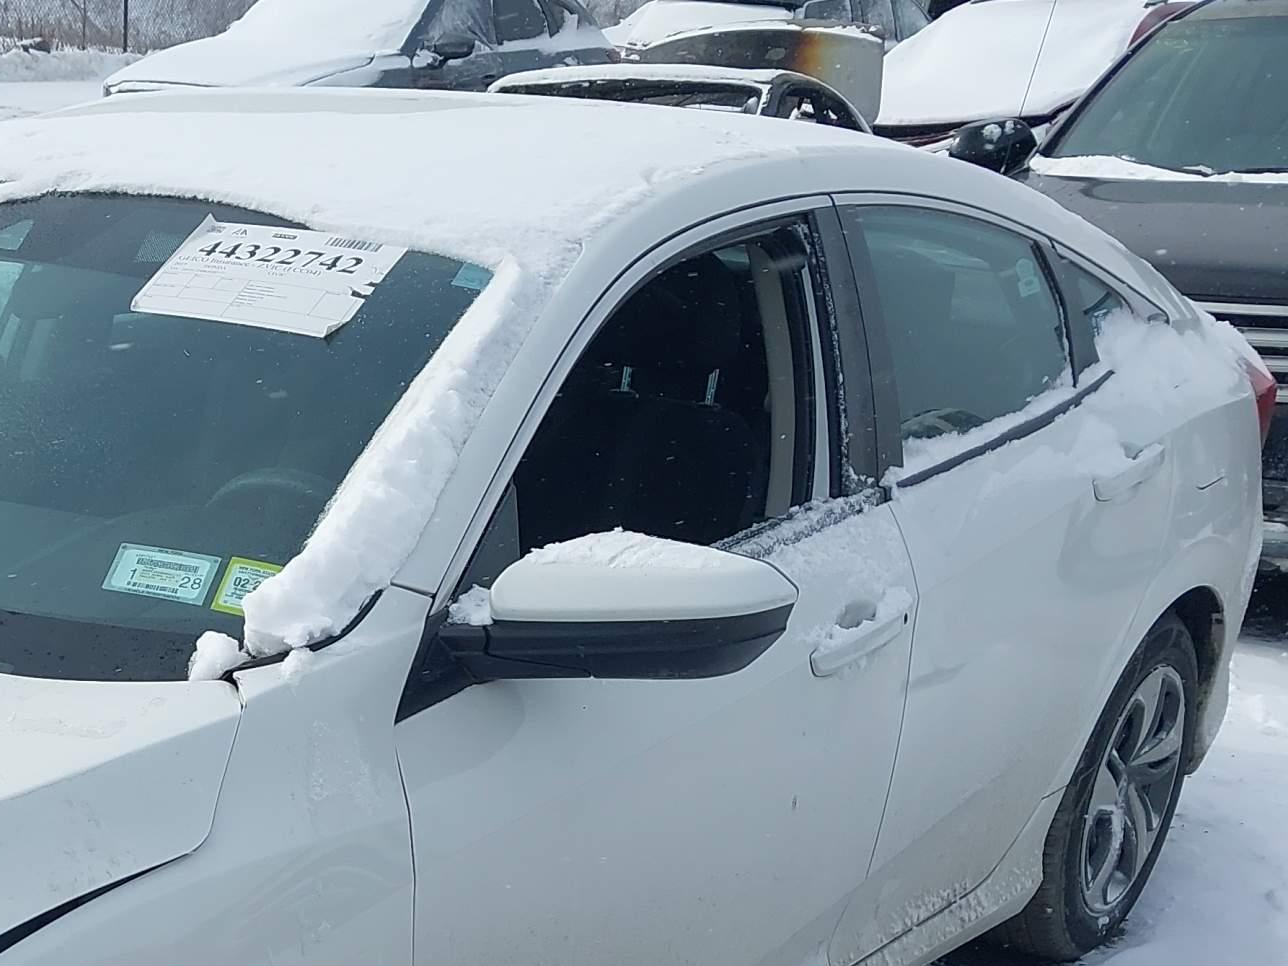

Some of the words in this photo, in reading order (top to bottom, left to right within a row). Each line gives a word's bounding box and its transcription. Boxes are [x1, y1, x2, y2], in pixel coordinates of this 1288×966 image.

[199, 240, 364, 276] 44322742
[129, 568, 138, 581] 1
[178, 576, 203, 590] 28
